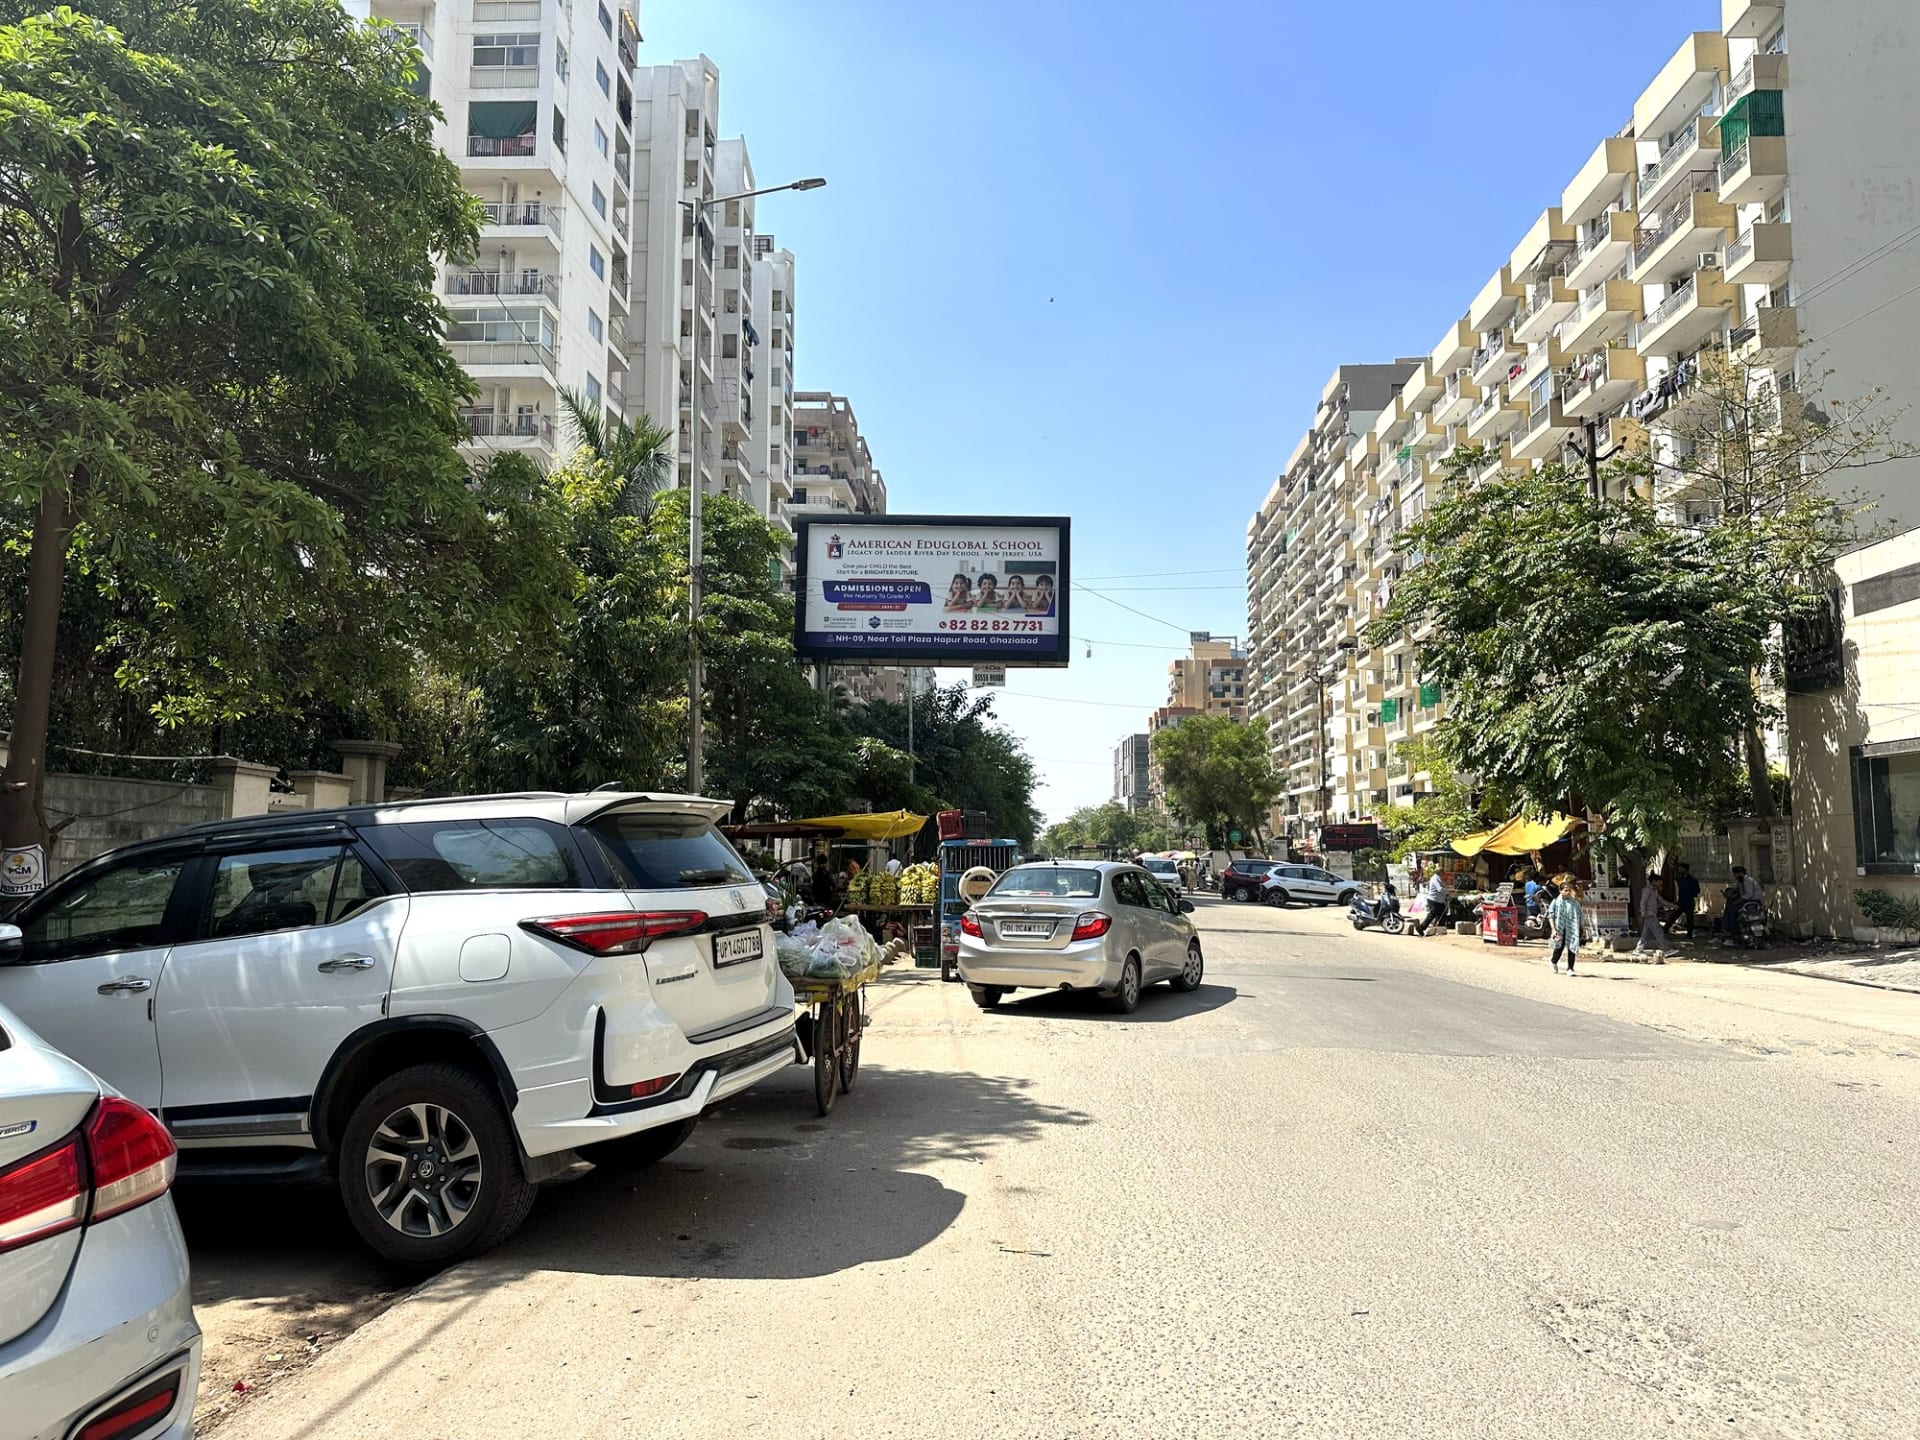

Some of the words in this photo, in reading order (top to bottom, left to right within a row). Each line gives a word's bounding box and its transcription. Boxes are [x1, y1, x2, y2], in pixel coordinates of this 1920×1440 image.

[848, 540, 912, 548] AMERICAN
[917, 540, 988, 549] EDUGLOBAL
[992, 540, 1043, 550] SCHOOL
[950, 620, 967, 630] 82
[971, 620, 988, 630] 82
[992, 620, 1009, 630] 82
[1013, 621, 1043, 631] 7731
[836, 635, 865, 643] NH-09,
[934, 636, 960, 644] Hapur
[963, 636, 988, 644] Road,
